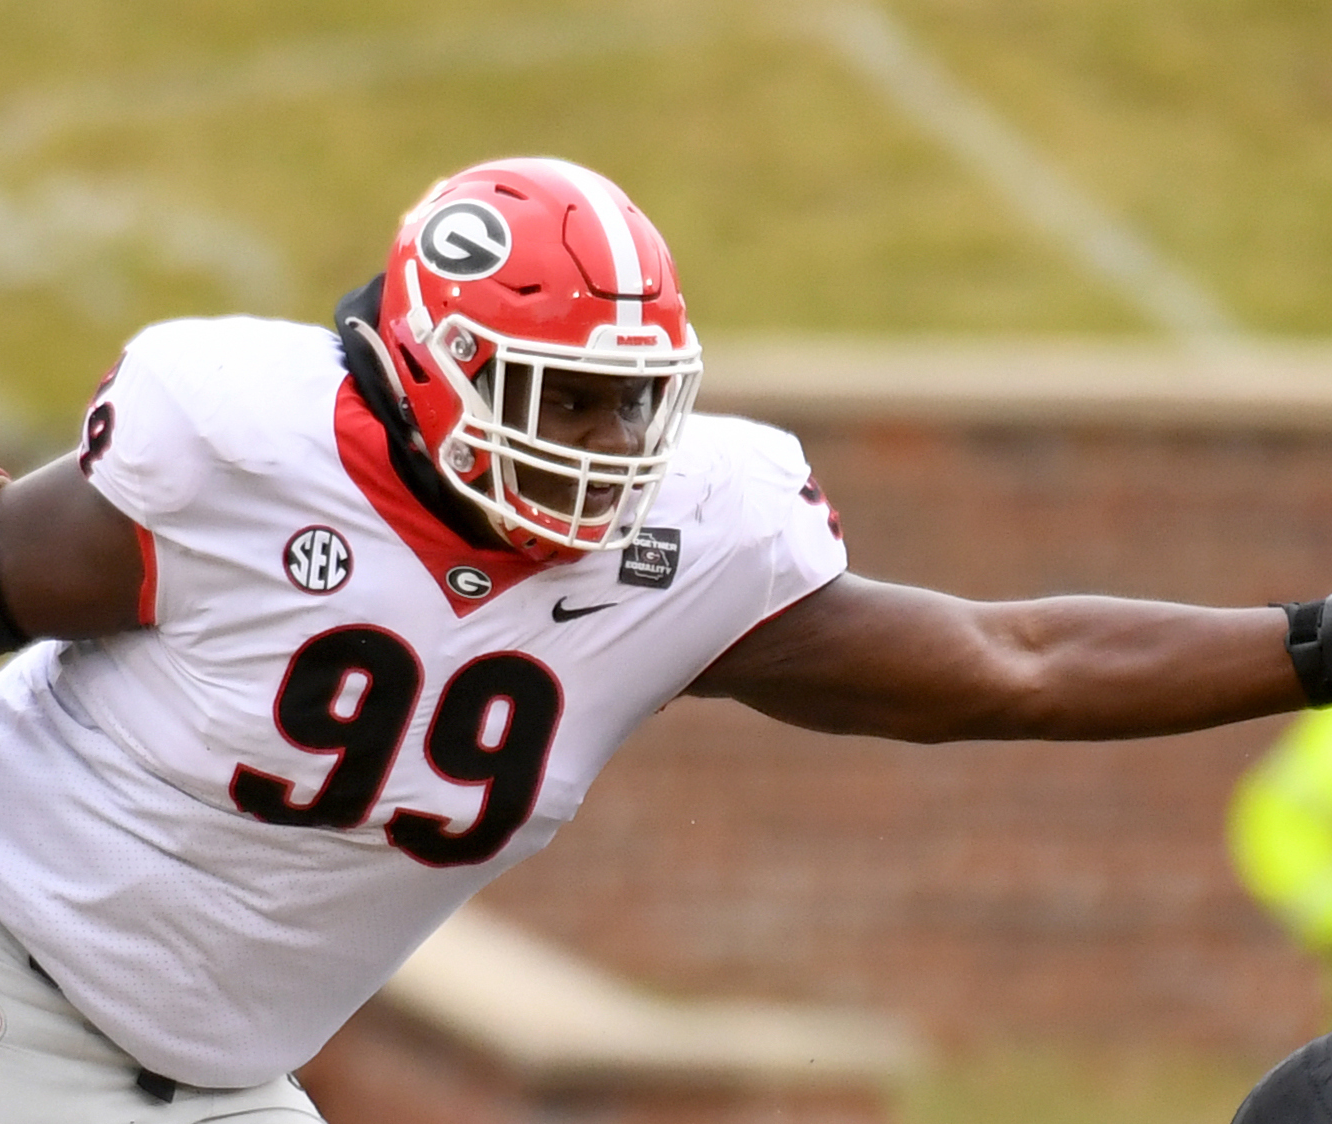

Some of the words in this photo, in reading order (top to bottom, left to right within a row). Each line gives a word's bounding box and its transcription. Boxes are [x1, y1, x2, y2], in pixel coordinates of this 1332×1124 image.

[422, 203, 509, 275] G
[289, 528, 349, 591] SEC
[631, 537, 678, 552] OGETHER
[447, 567, 491, 596] G
[229, 623, 566, 869] 99
